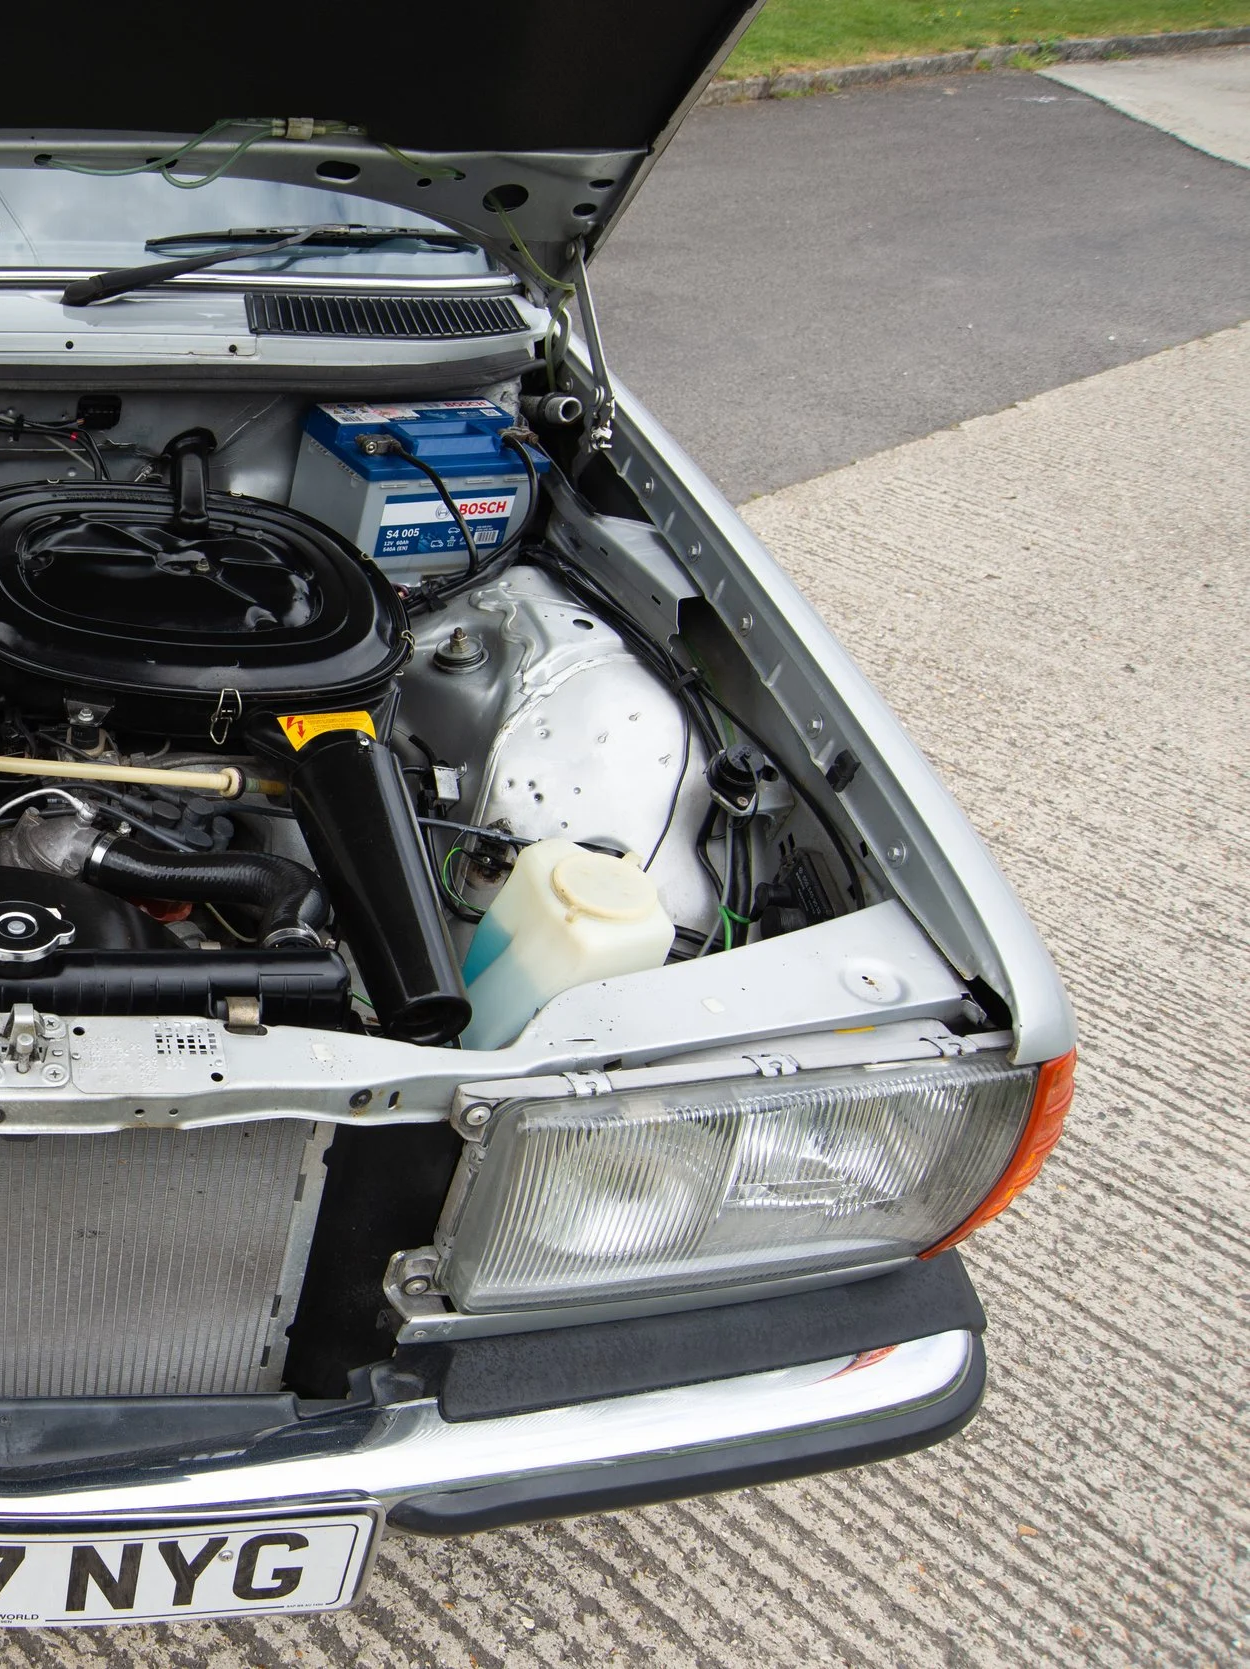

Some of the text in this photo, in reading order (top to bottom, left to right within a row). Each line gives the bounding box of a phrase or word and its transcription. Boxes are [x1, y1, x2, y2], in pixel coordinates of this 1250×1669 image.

[459, 501, 507, 515] BOSCH
[386, 528, 420, 539] S4 005
[65, 1532, 310, 1612] NYG
